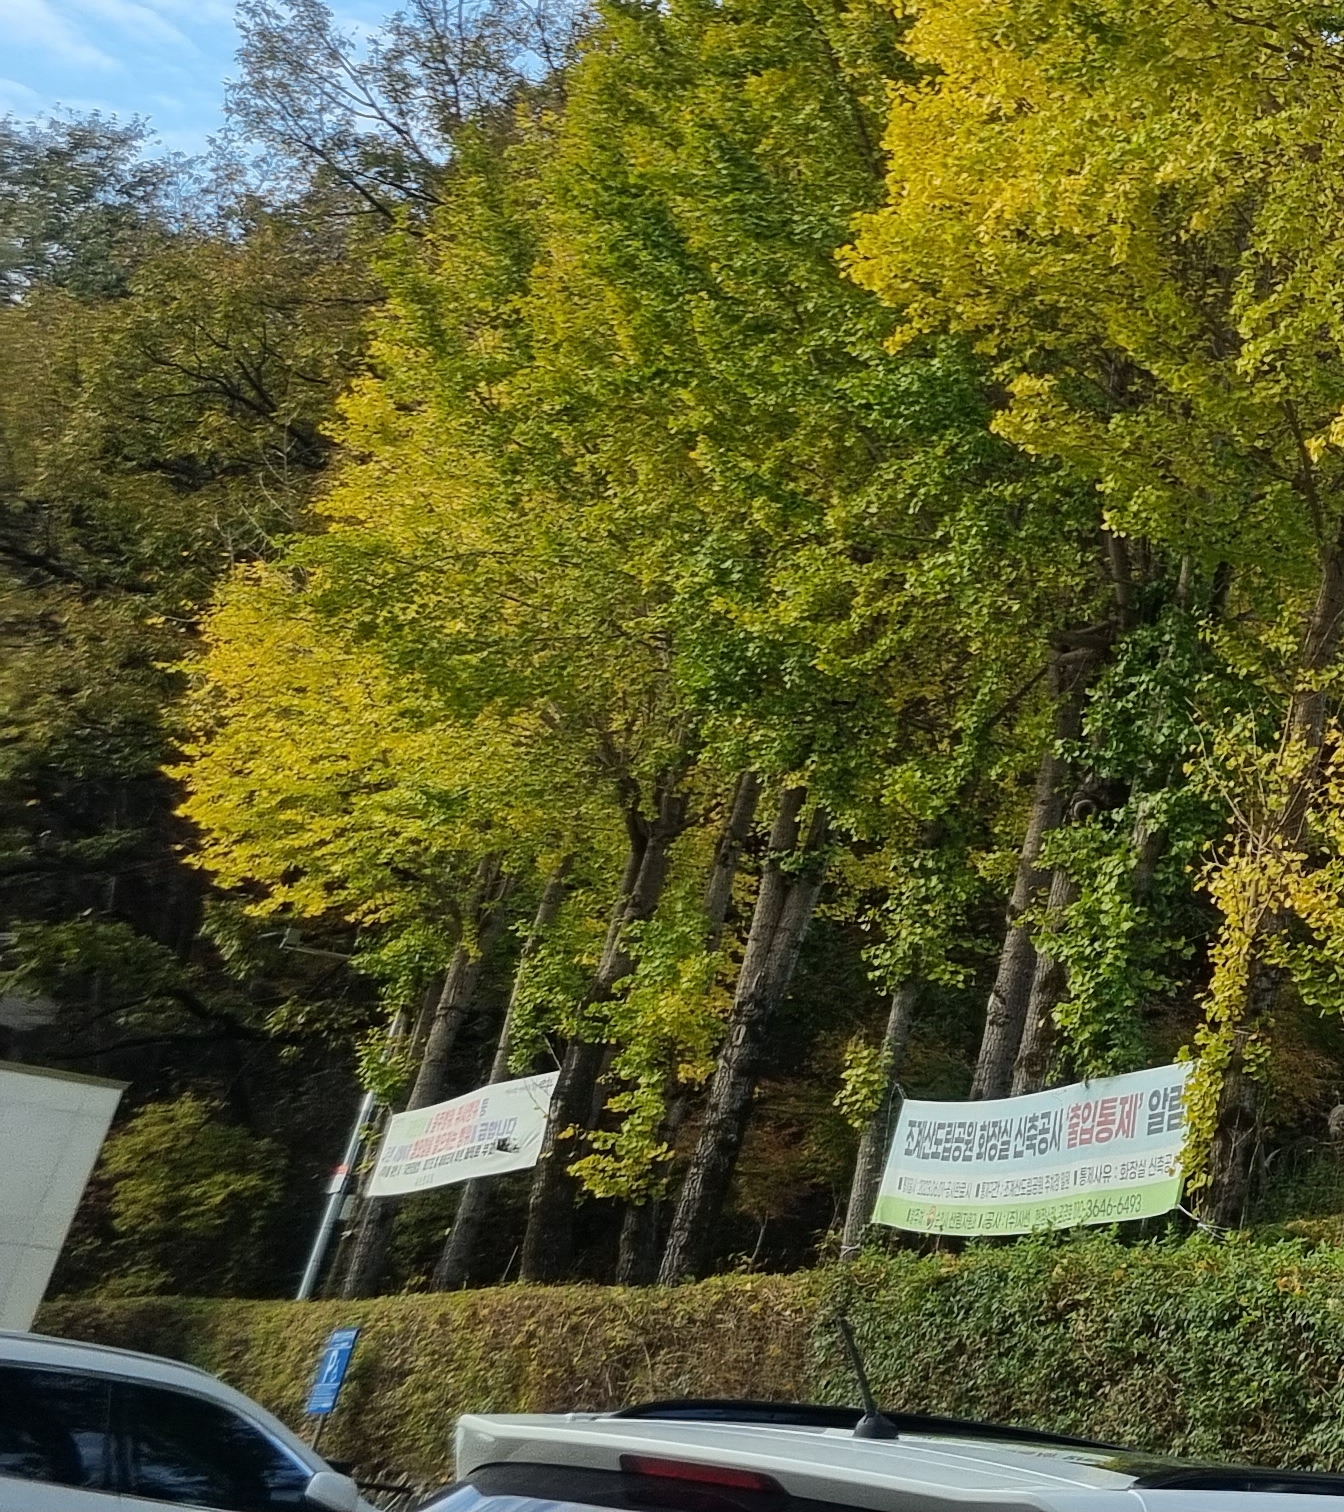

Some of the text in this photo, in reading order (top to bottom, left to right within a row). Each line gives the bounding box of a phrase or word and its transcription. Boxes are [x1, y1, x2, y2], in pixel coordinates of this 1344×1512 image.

[904, 1116, 977, 1163] 조계산도립공원
[976, 1117, 1012, 1162] 화장실
[1012, 1107, 1064, 1159] 신축공사
[1079, 1153, 1180, 1187] 통제사유 화장실 신축공
